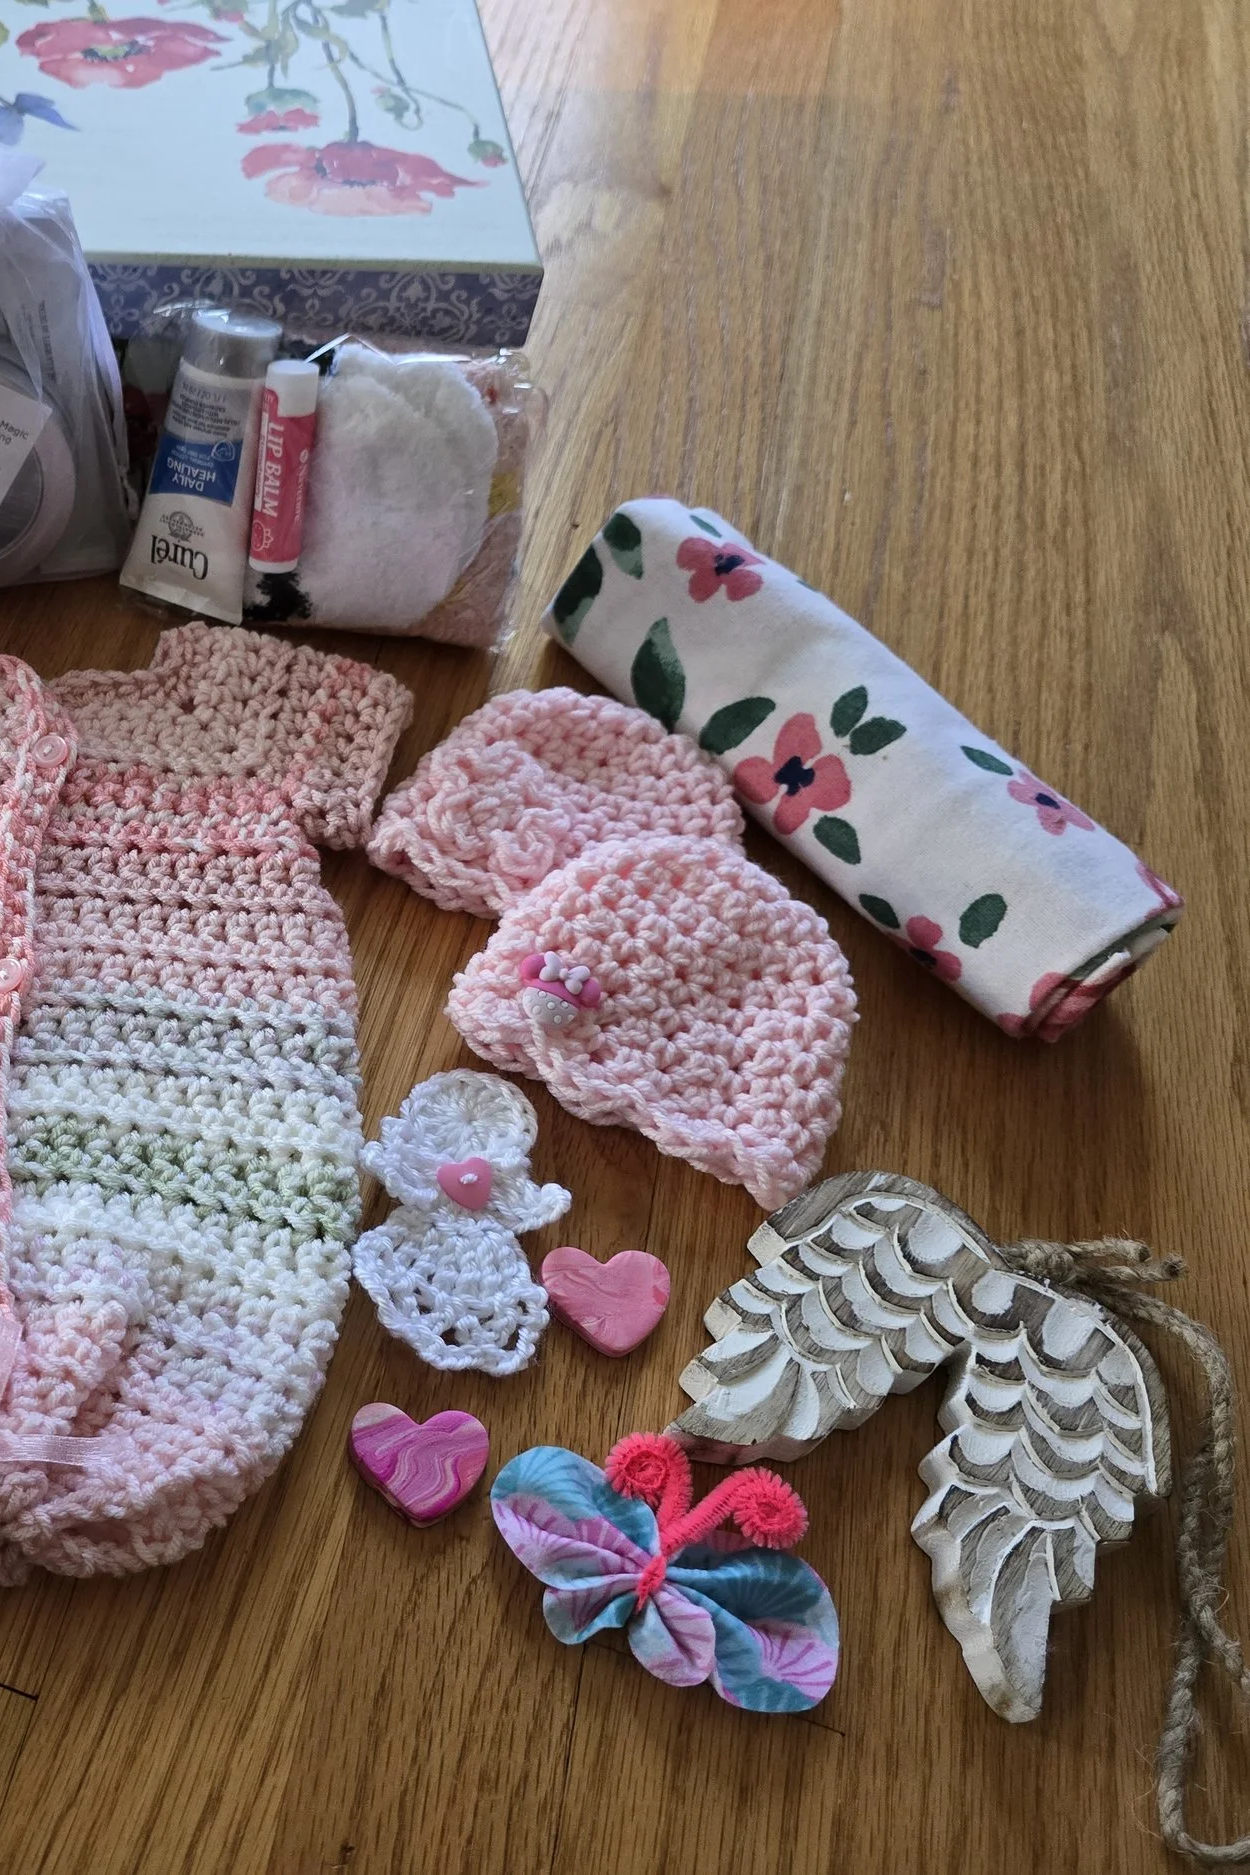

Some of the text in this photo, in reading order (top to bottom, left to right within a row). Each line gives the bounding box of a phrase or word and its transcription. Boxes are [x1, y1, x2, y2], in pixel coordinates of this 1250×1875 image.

[268, 420, 285, 456] LIP
[166, 456, 217, 483] HEALING
[172, 472, 205, 493] DAILY
[263, 461, 283, 518] BALM
[151, 534, 209, 581] Curél
